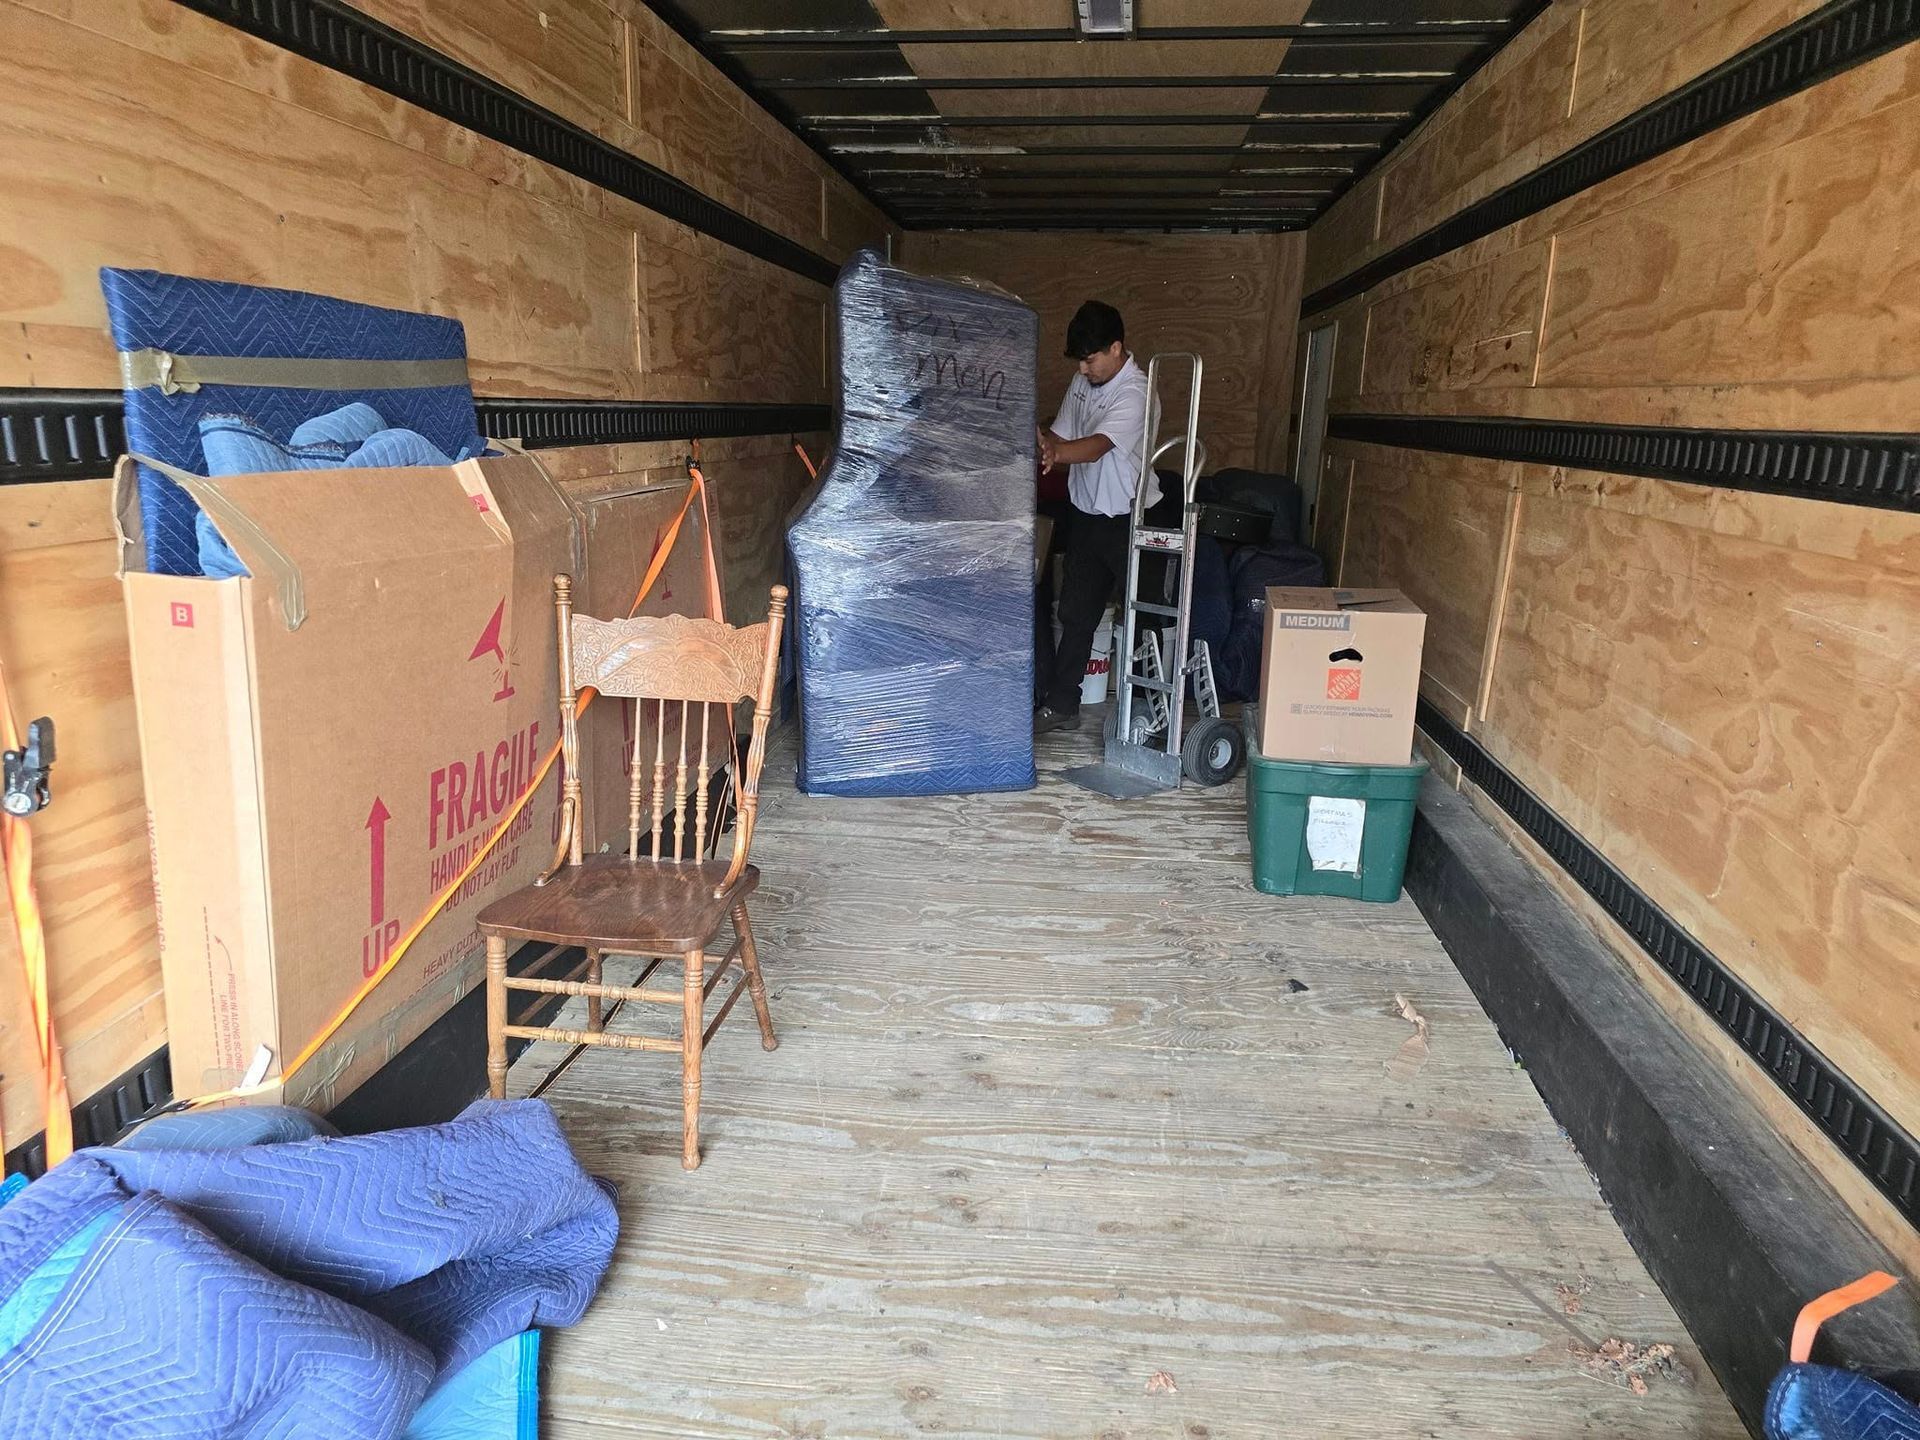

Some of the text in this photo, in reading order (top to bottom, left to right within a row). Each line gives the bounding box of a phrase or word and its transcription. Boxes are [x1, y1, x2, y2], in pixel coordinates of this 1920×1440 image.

[176, 607, 188, 621] B
[1285, 615, 1345, 628] MEDIUM
[1328, 670, 1361, 699] HOME
[429, 721, 538, 850] FRAGILE
[463, 871, 483, 901] NOT
[484, 859, 501, 887] LAY
[502, 845, 520, 876] FLAT
[363, 919, 400, 978] UP
[423, 944, 455, 979] HEAVY
[228, 973, 236, 1000] PRESS
[230, 1002, 238, 1010] IN
[231, 1012, 239, 1040] ALONG
